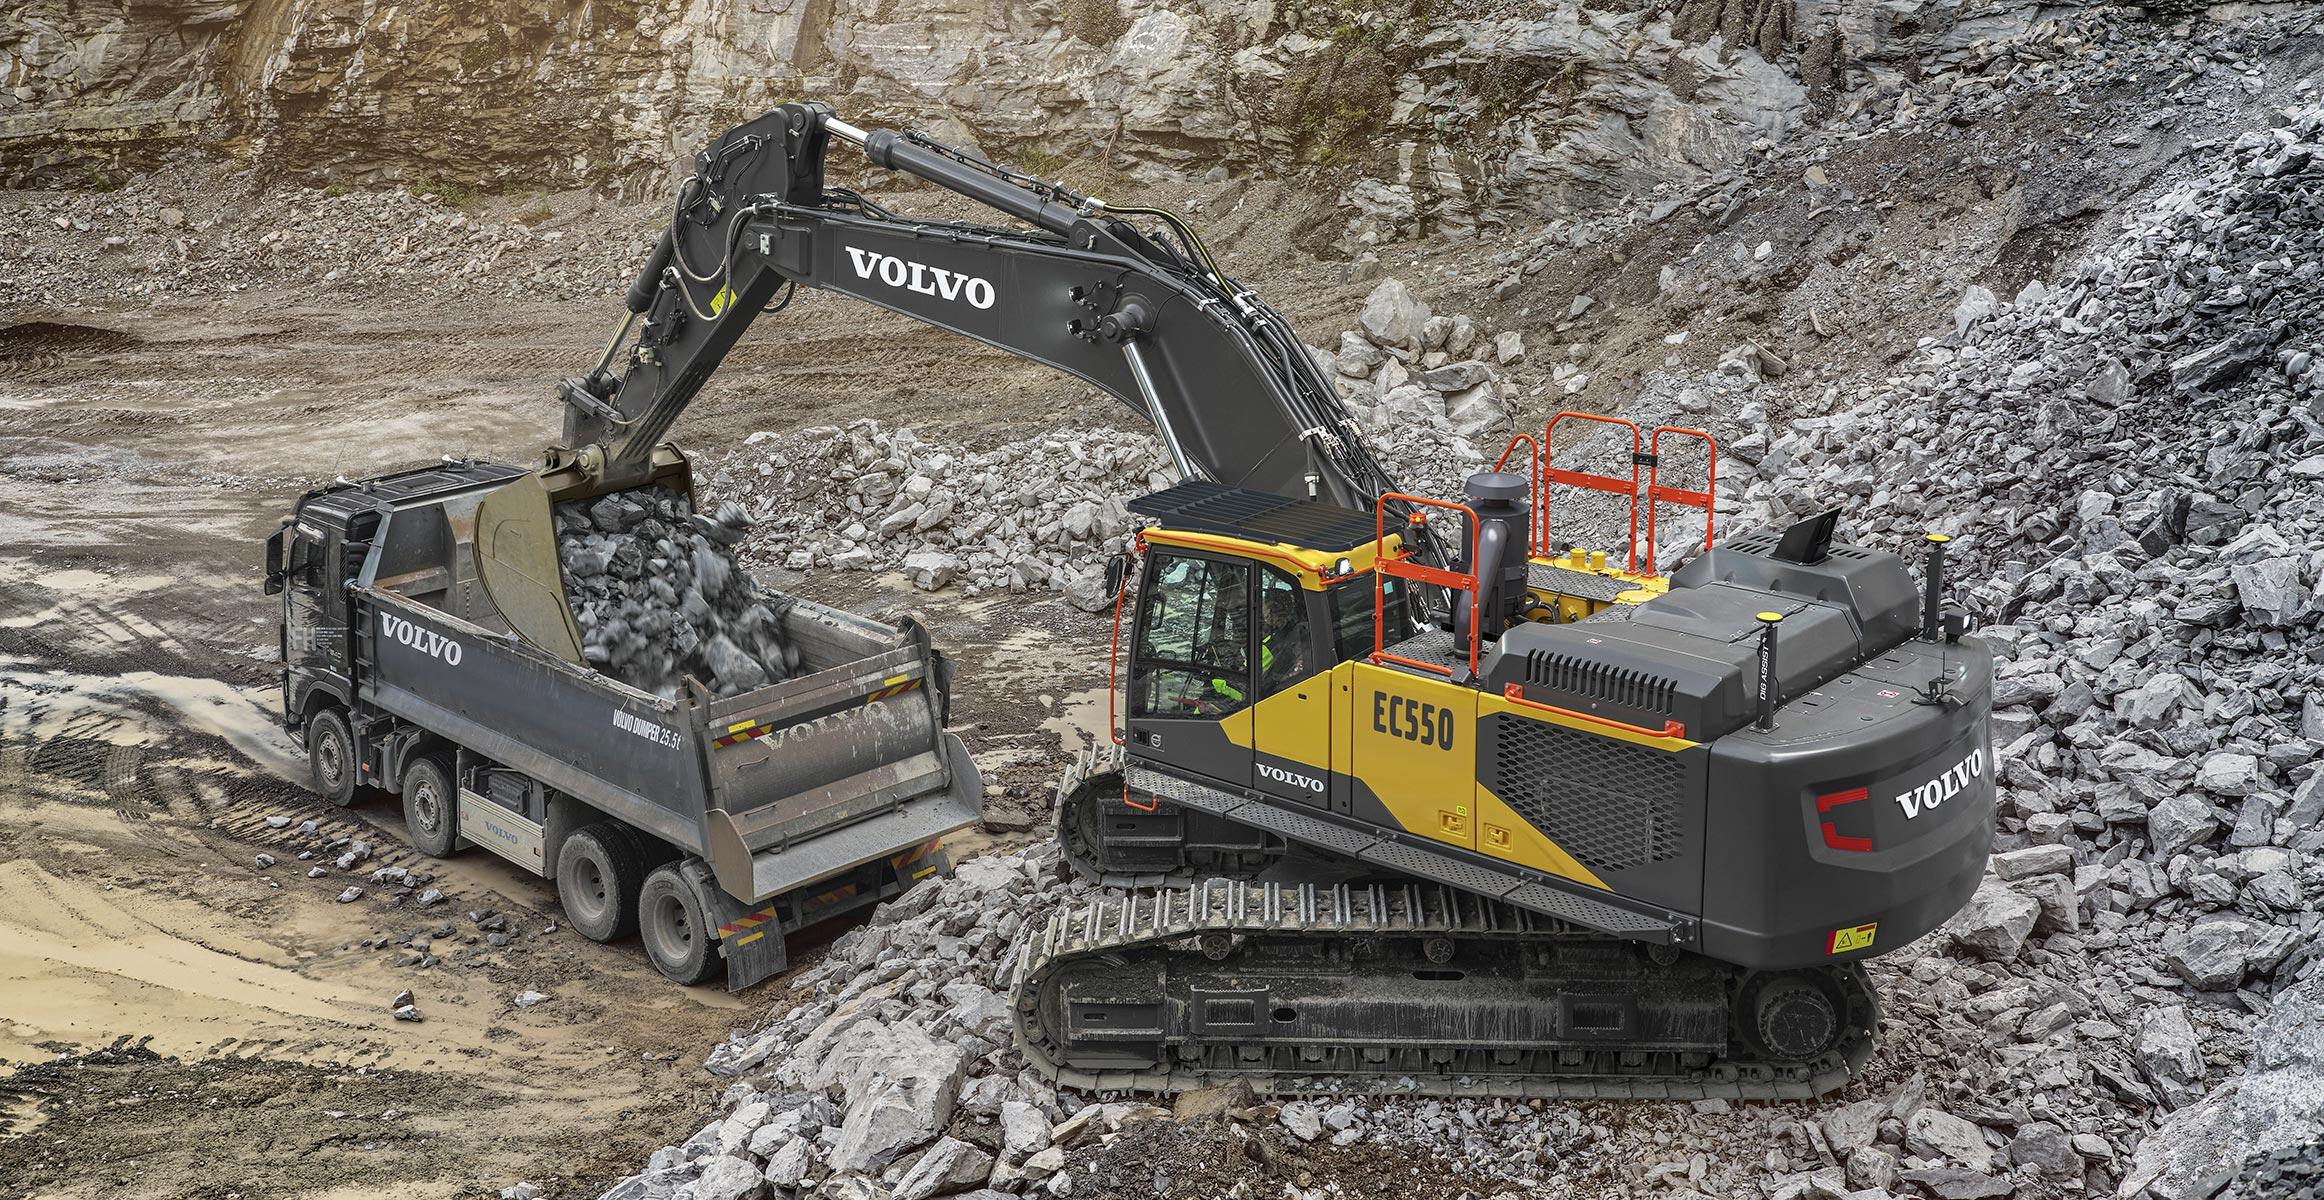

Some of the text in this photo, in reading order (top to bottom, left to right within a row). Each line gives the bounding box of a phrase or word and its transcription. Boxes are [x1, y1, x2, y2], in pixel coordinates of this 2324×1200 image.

[845, 246, 996, 310] VOLVO
[380, 611, 462, 666] VOLVO
[1759, 645, 1769, 701] DIG ASSIST
[613, 708, 634, 732] VOLVO
[632, 717, 661, 743] DUMPER
[1373, 690, 1454, 751] EC550
[1256, 763, 1325, 793] VOLVO
[1895, 748, 1983, 819] VOLVO
[485, 820, 519, 845] VOLVO
